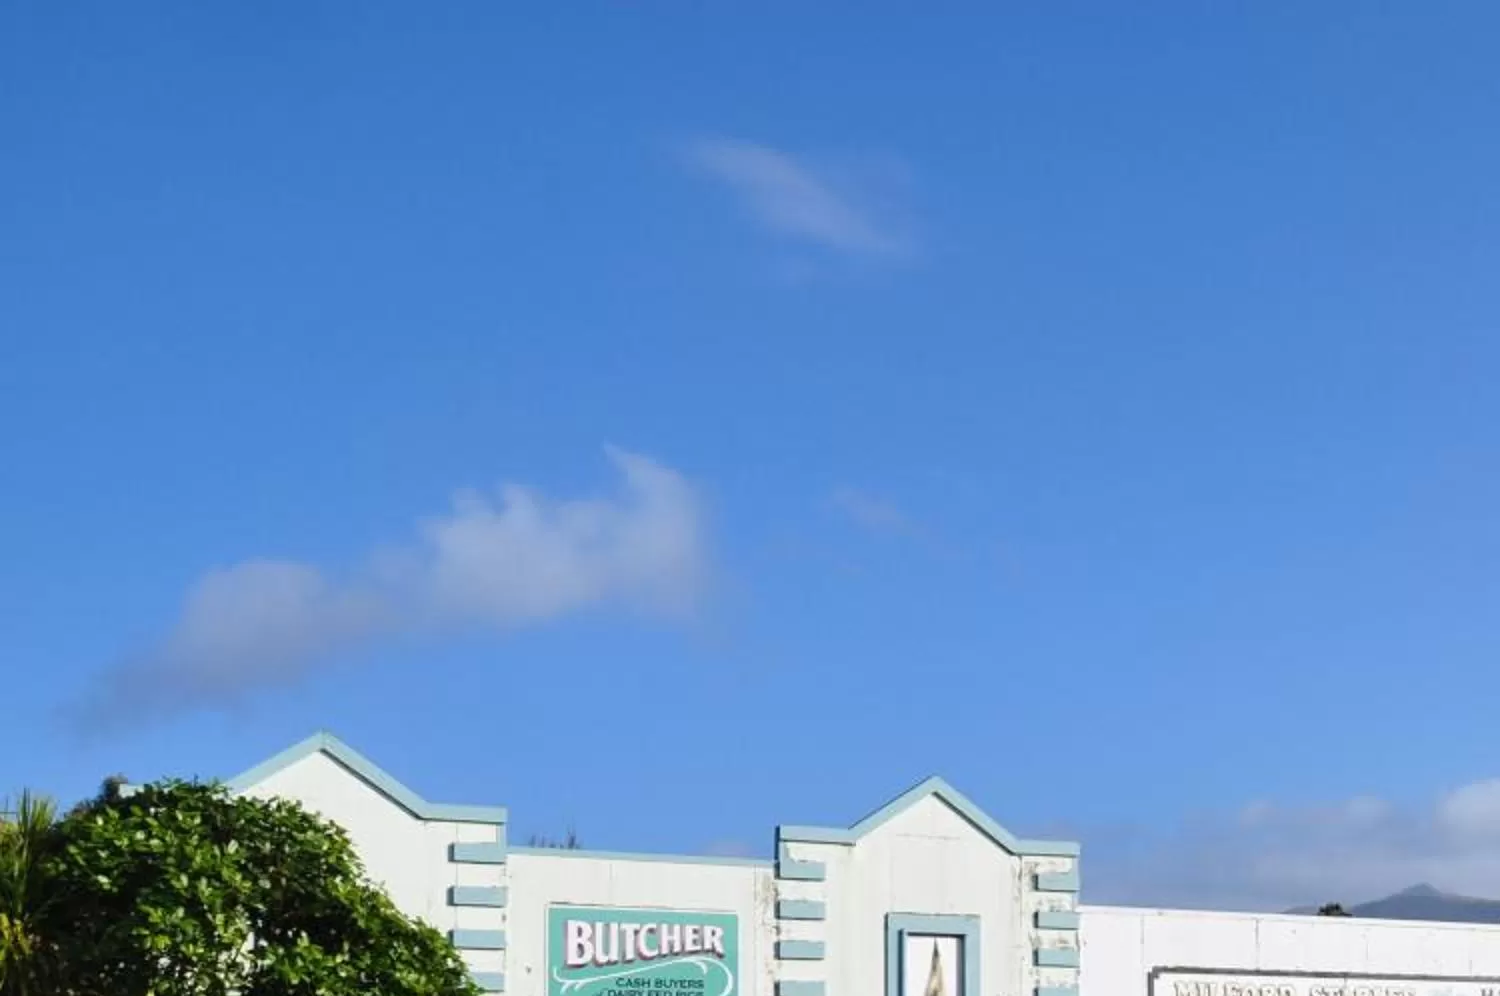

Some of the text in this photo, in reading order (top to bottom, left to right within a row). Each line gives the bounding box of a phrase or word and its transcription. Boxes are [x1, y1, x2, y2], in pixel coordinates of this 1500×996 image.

[564, 919, 725, 968] BUTCHER
[615, 977, 705, 990] CASH BUYERS
